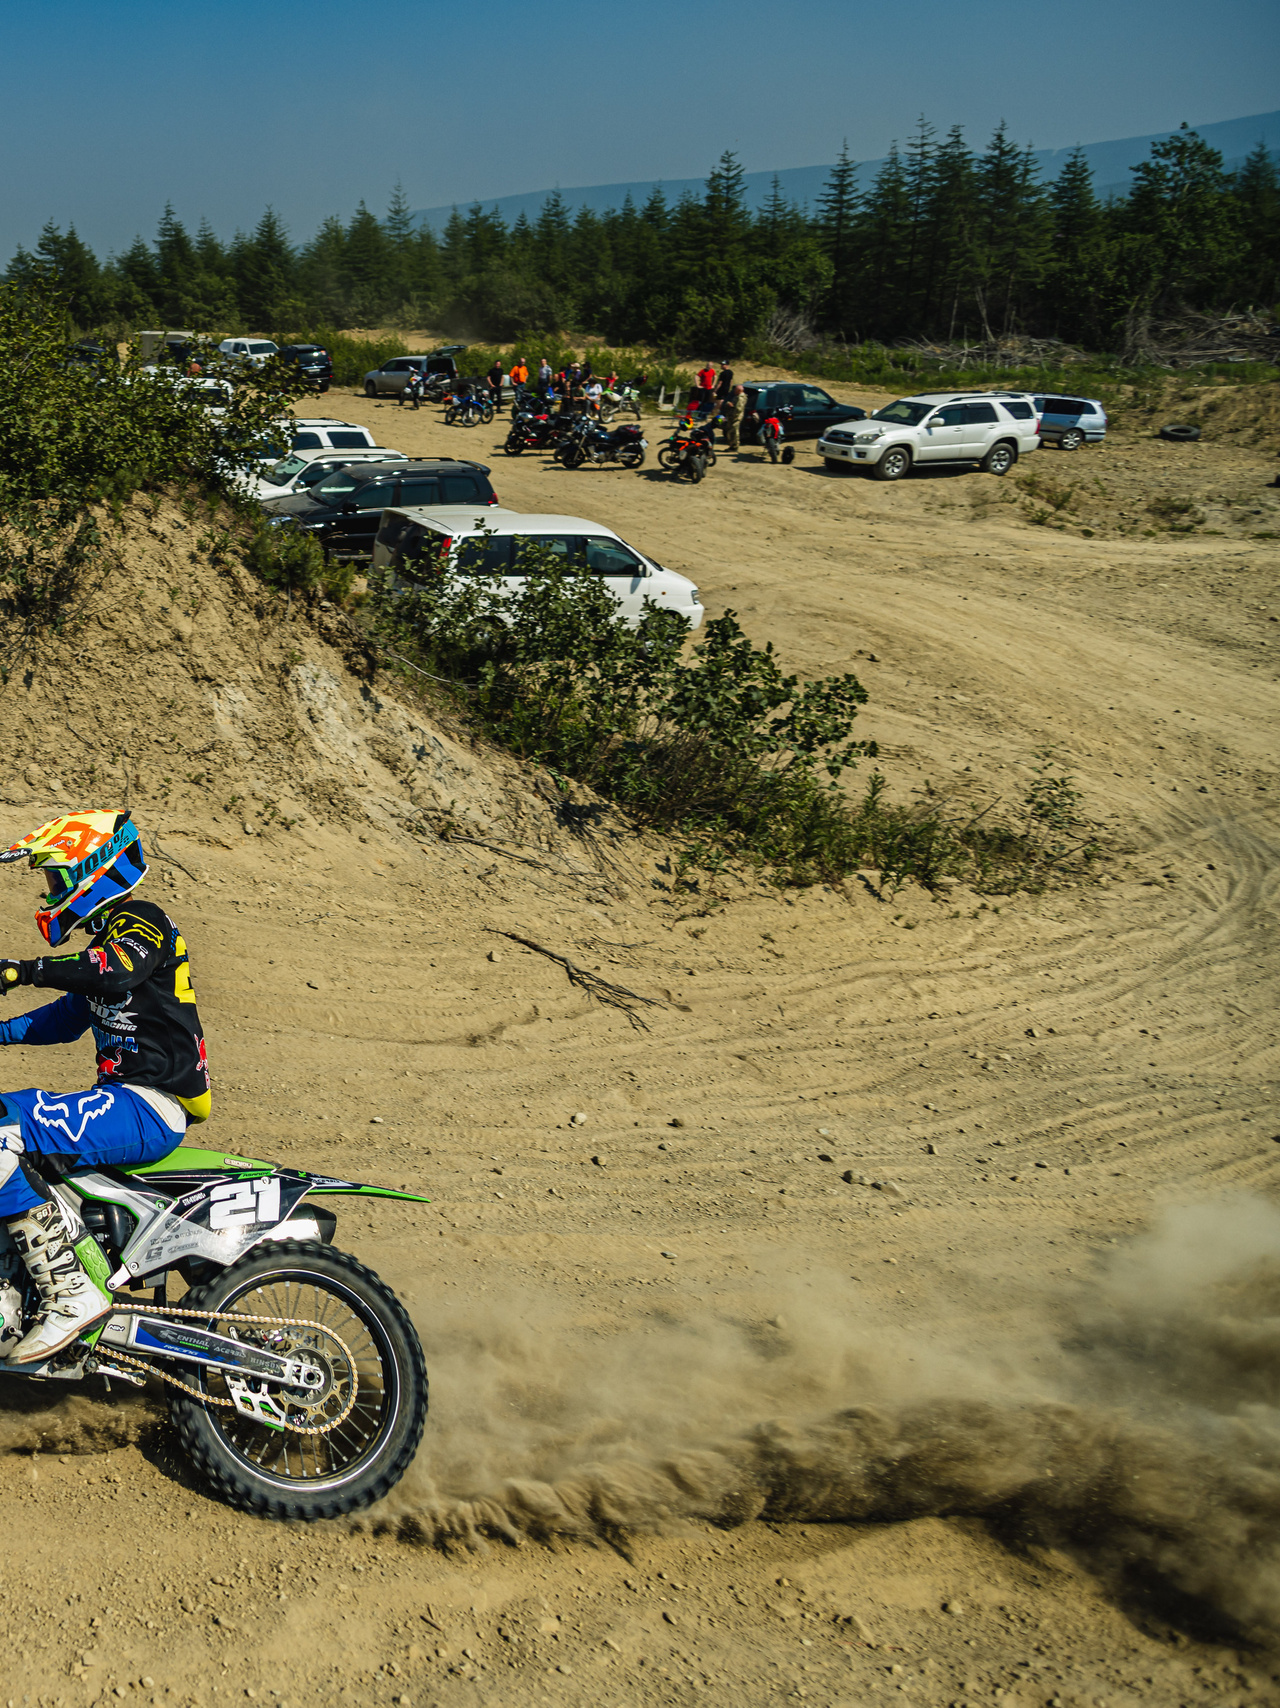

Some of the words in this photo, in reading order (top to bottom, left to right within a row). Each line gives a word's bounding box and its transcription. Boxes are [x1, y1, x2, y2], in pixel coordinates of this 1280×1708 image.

[90, 1001, 138, 1025] FOX
[102, 1019, 137, 1031] RACING
[210, 1177, 280, 1229] 21
[163, 1344, 199, 1356] RACING
